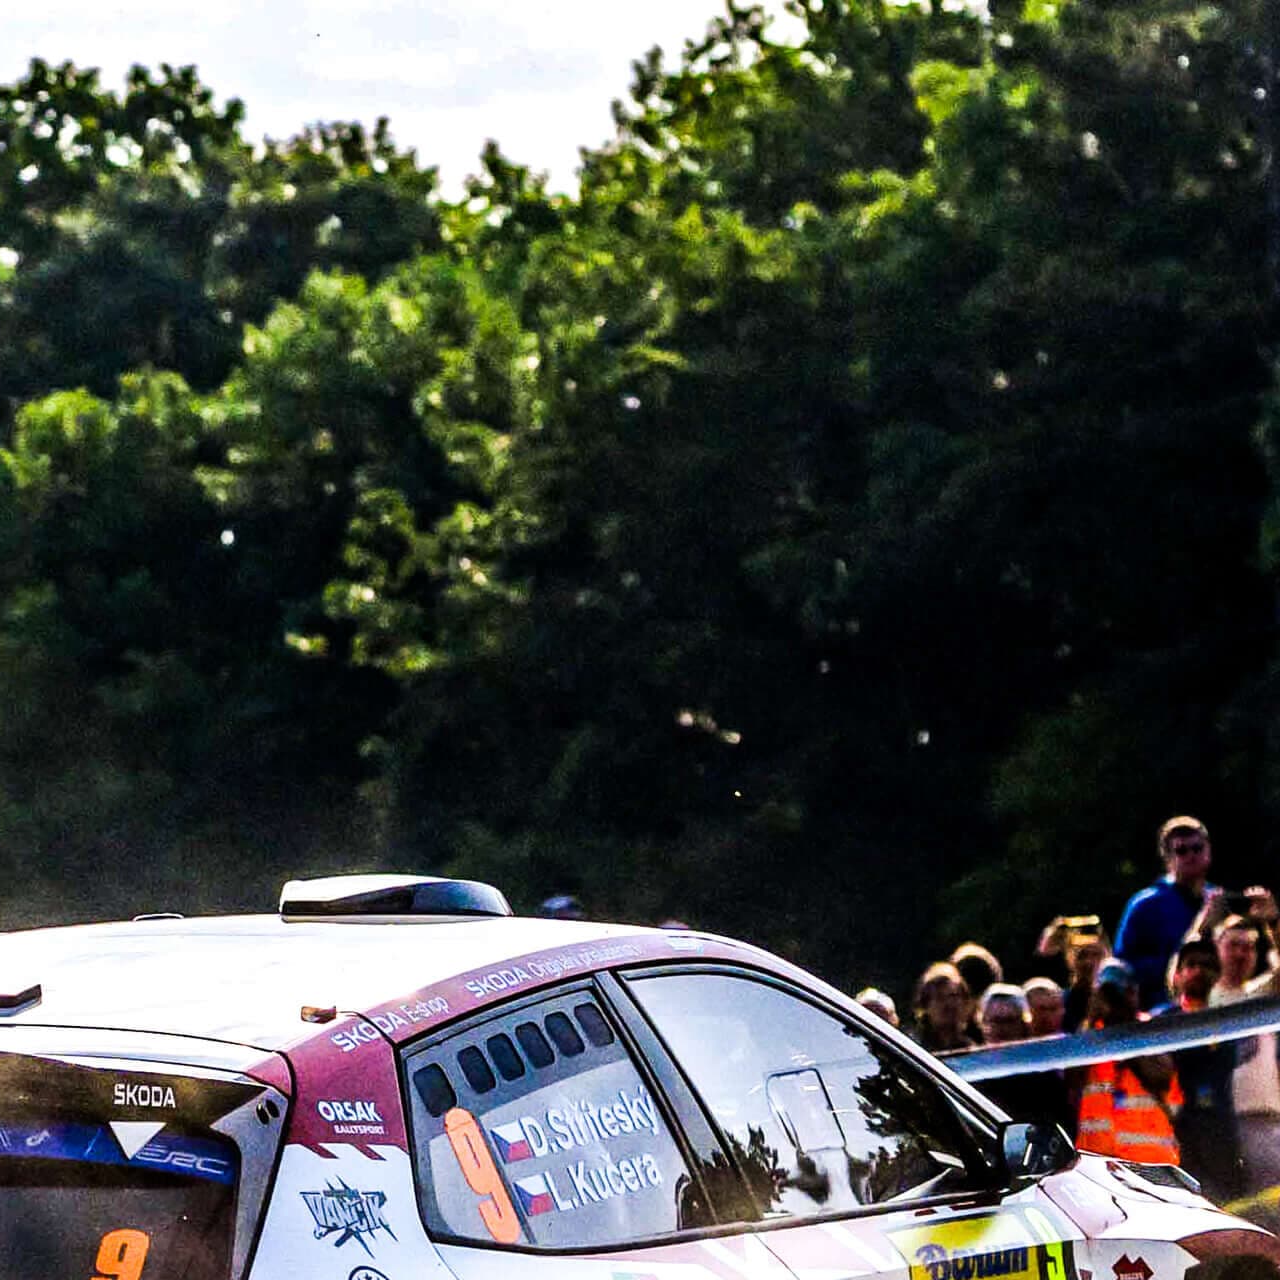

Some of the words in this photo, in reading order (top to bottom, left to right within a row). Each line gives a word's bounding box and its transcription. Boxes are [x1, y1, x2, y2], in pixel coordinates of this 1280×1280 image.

[400, 996, 450, 1024] E-shop
[317, 1100, 383, 1122] ORSAK
[444, 1106, 522, 1244] 9
[544, 1151, 663, 1212] L.Kučera
